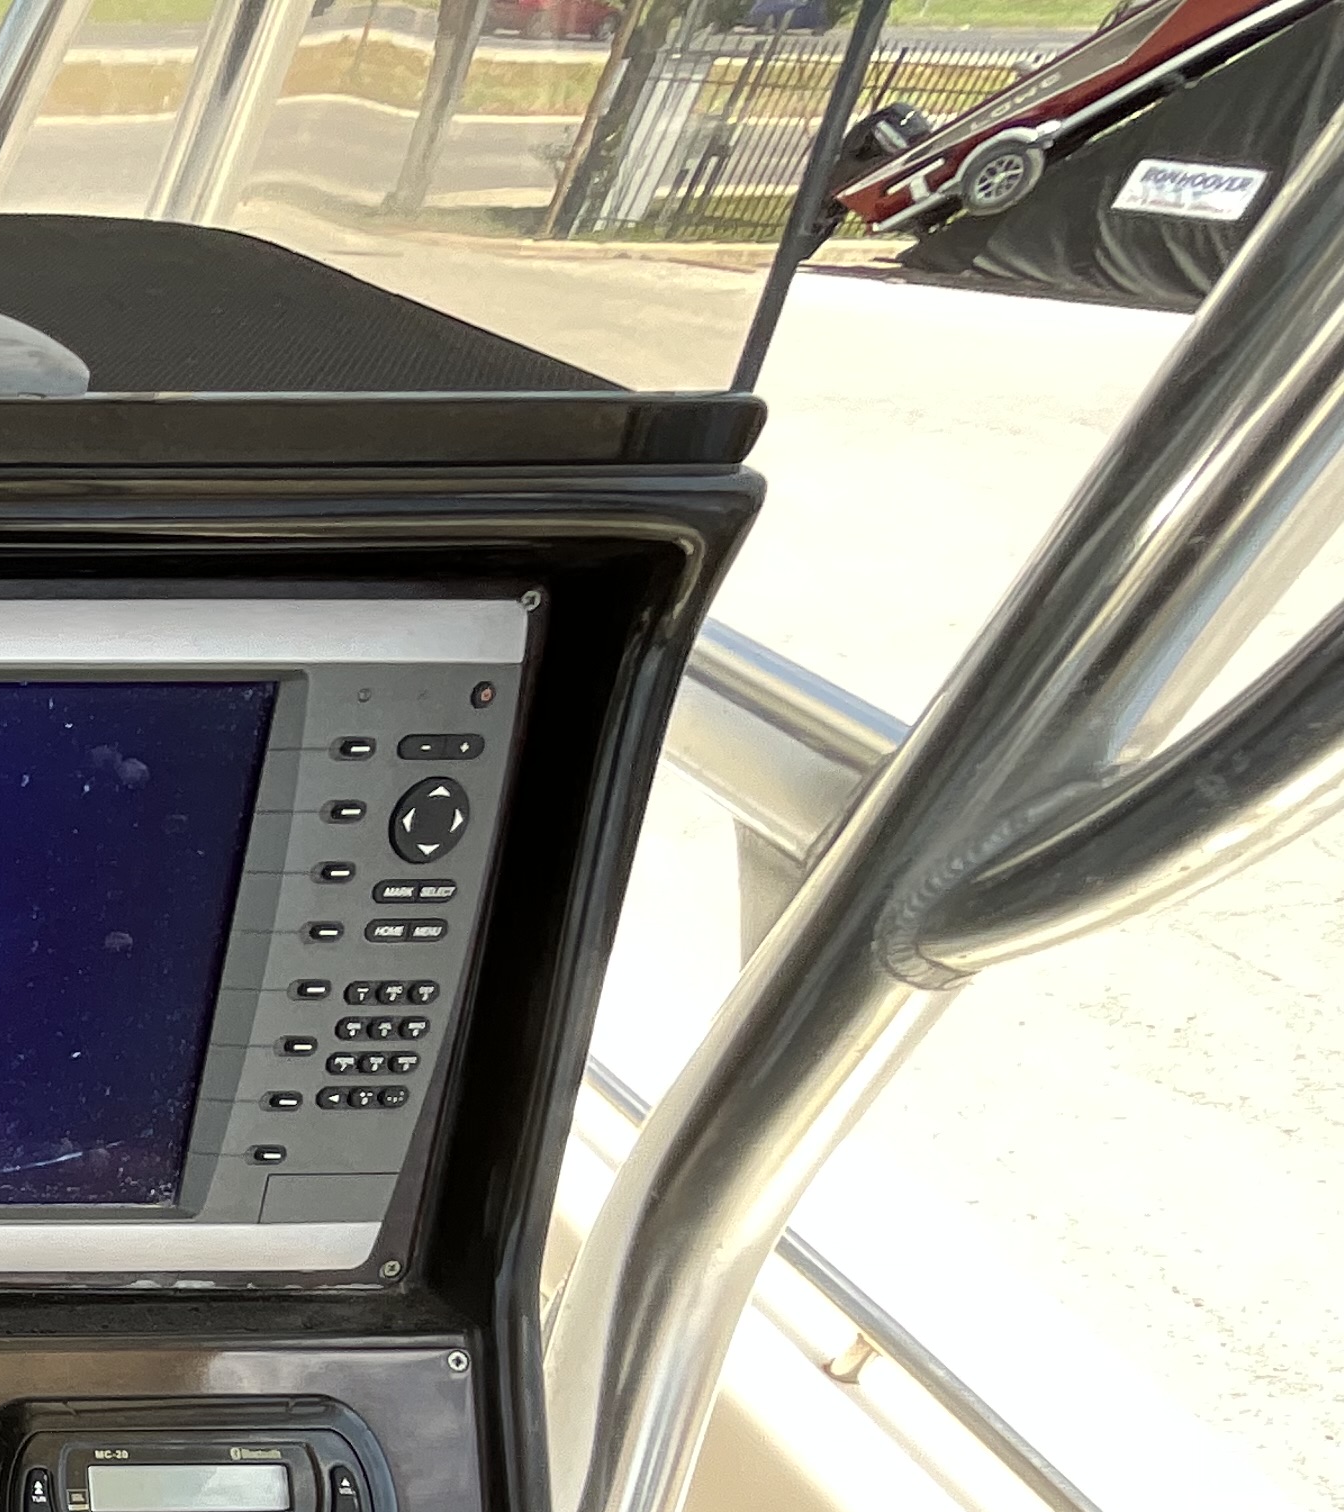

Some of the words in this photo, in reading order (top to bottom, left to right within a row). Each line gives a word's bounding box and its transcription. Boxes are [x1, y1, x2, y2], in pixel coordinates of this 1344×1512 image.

[383, 886, 414, 898] MARK
[420, 886, 456, 898] SELECT
[94, 1449, 129, 1459] MC-20
